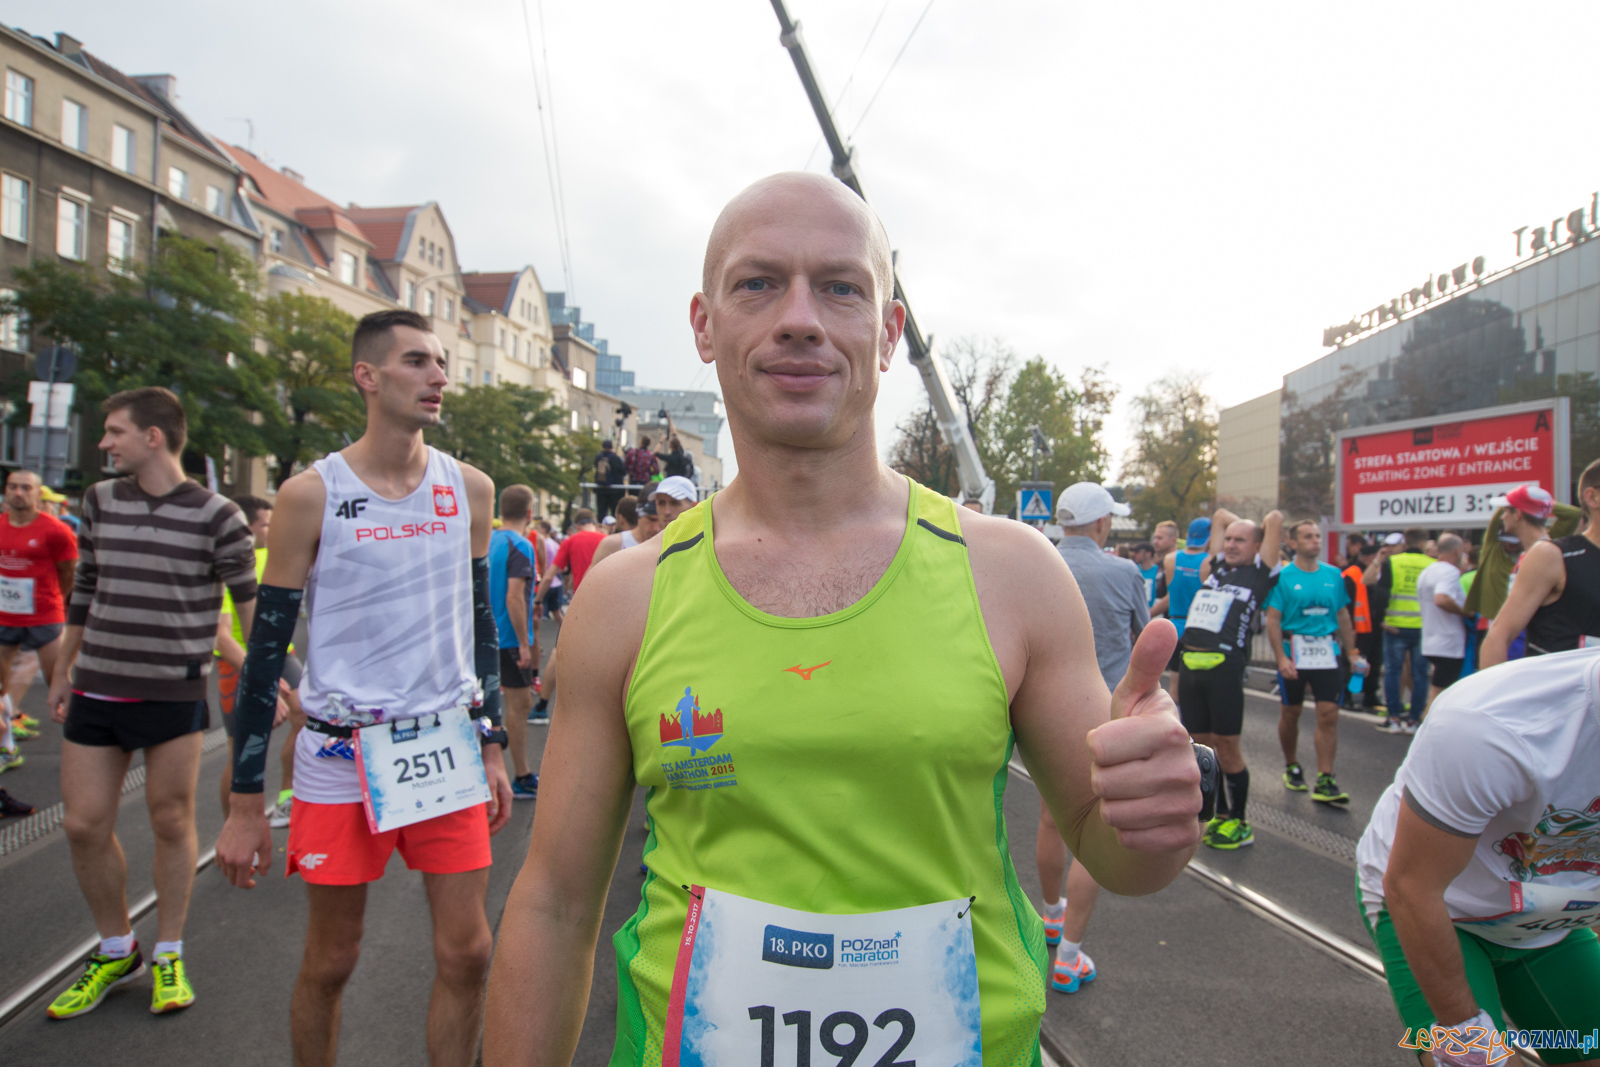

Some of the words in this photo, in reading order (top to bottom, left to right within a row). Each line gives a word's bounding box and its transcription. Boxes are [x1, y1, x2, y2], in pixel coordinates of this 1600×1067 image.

[1534, 411, 1550, 432] A
[1348, 438, 1359, 455] A
[1354, 455, 1394, 470] STREFA
[1397, 447, 1461, 465] STARTOWA
[1464, 446, 1471, 458] /
[1474, 436, 1539, 456] WEJŚCIE
[1359, 468, 1411, 484] STARTING
[1413, 464, 1447, 480] ZONE
[1449, 463, 1455, 476] /
[1458, 456, 1532, 476] ENTRANCE
[1379, 492, 1455, 515] PONIŻEJ
[1466, 493, 1507, 512] 3:1
[355, 521, 447, 542] POLSKA
[1302, 647, 1328, 657] 2370
[393, 746, 455, 784] 2511
[675, 753, 733, 771] AMSTERDAM
[710, 763, 735, 776] 2015
[412, 777, 446, 790] Mateusz
[684, 903, 699, 946] 15.10.2017
[769, 937, 789, 954] 18.
[791, 941, 828, 959] PKO
[841, 949, 899, 962] maraton
[748, 1005, 917, 1067] 1192
